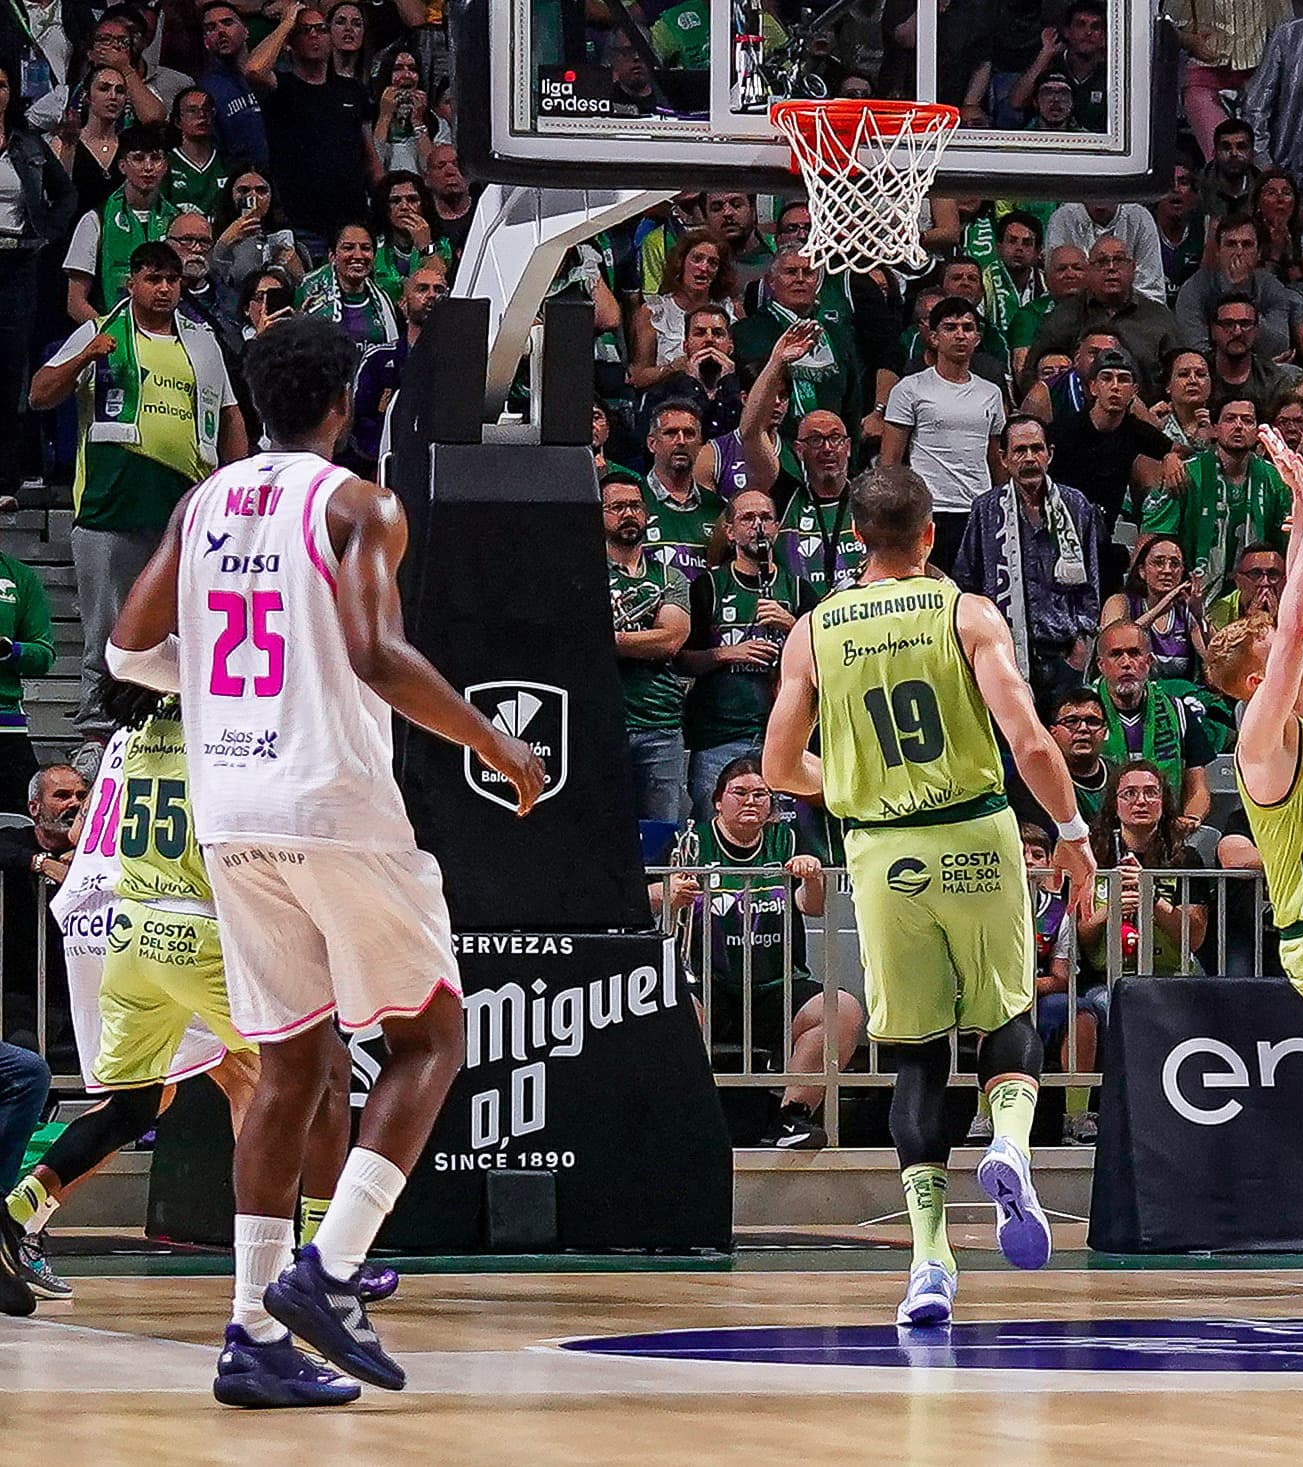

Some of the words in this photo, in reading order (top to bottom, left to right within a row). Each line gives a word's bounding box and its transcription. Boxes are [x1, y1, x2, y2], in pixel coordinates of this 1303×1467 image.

[541, 78, 573, 97] liga
[541, 95, 610, 112] endesa
[153, 374, 197, 397] Unicaj
[207, 590, 286, 698] 25
[862, 679, 946, 770] 19
[120, 778, 188, 860] 55
[940, 851, 1001, 868] COSTA
[941, 869, 972, 882] DEL
[975, 866, 1001, 881] SOL
[737, 896, 787, 915] Unicaj
[62, 907, 114, 937] arcel
[143, 920, 197, 940] COSTA
[139, 935, 166, 951] DEL
[167, 940, 197, 954] SOL
[726, 931, 781, 948] mlaga
[462, 937, 678, 1069] Miguel
[471, 1061, 546, 1150] 0,0
[434, 1152, 508, 1171] SINCE
[517, 1150, 576, 1171] 1890
